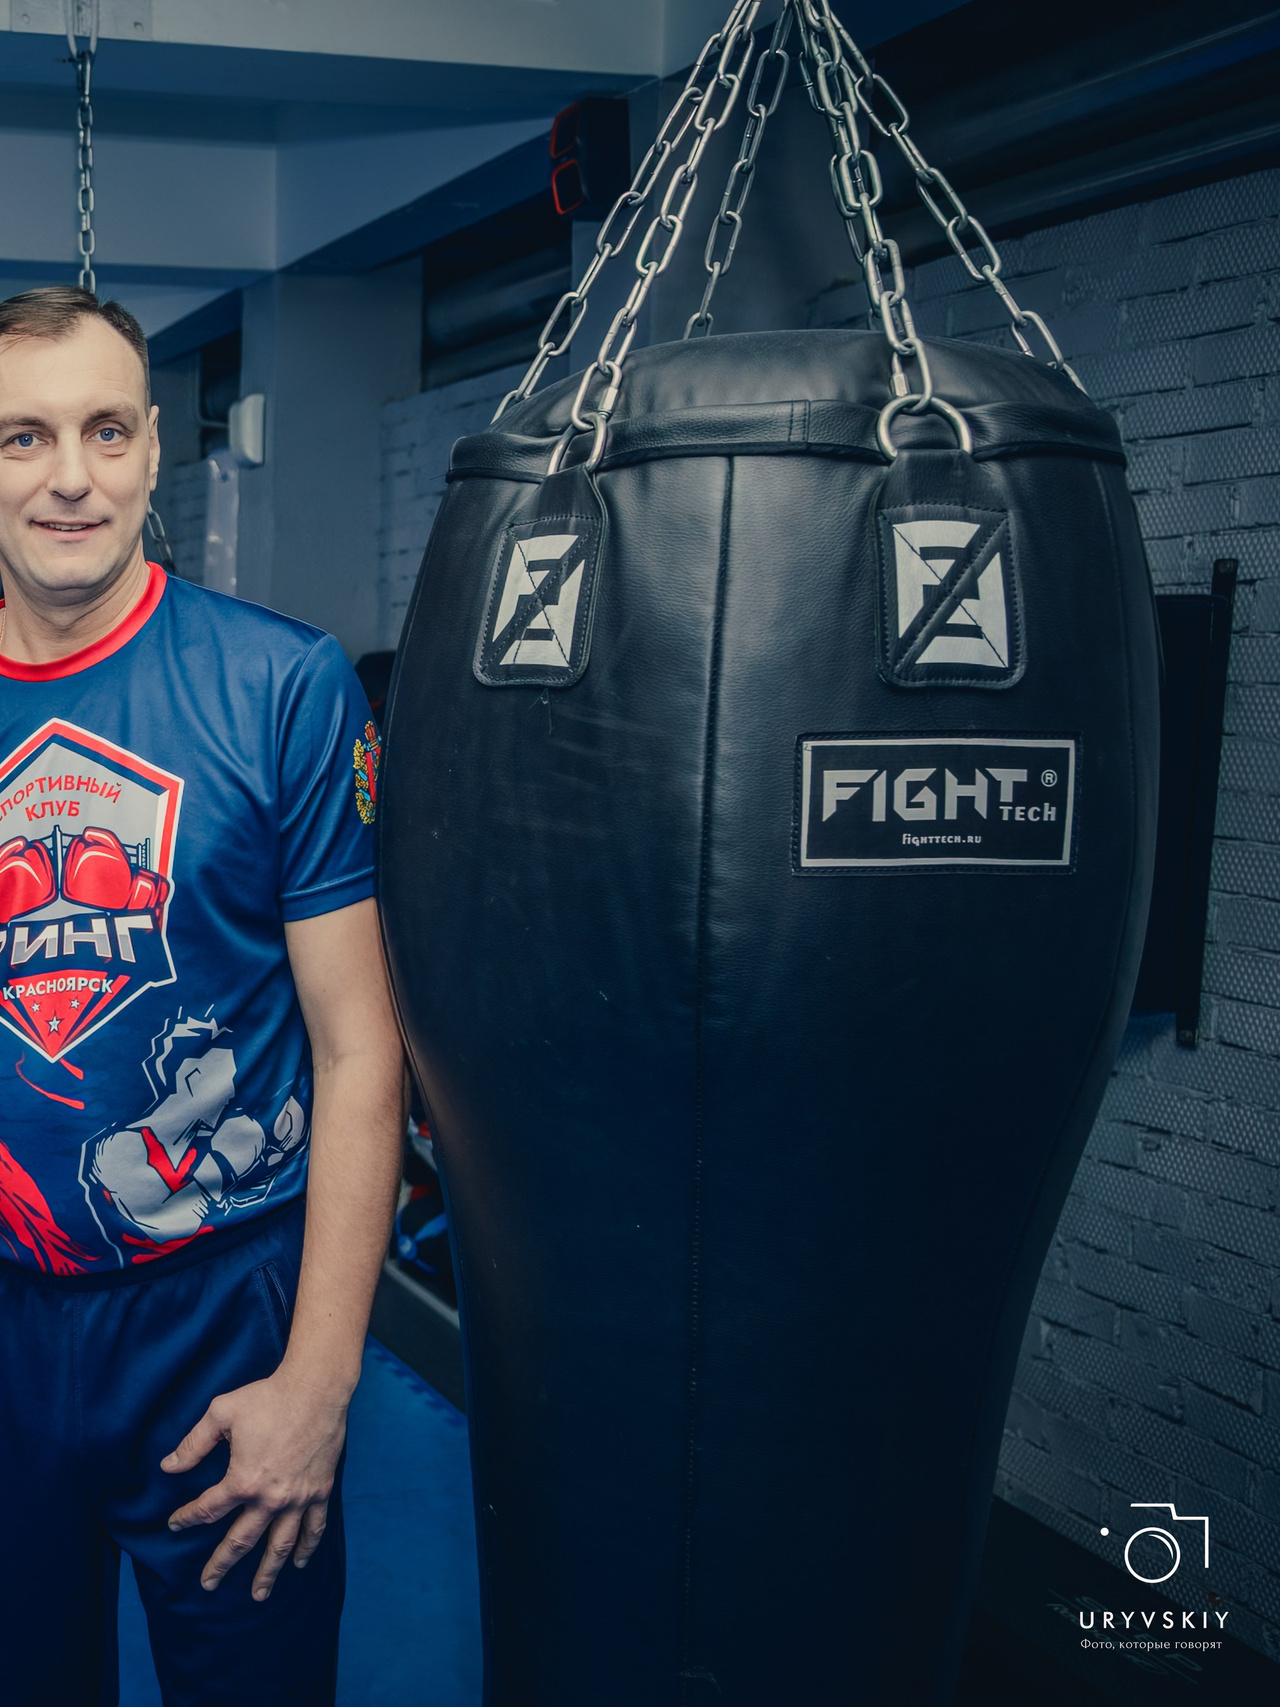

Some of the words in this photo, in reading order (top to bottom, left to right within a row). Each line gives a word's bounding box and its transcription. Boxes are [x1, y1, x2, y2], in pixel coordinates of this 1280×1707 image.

[822, 768, 1027, 822] FIGHT
[25, 800, 80, 822] КЛУБ
[2, 976, 114, 1000] КРАСНОЯРСК
